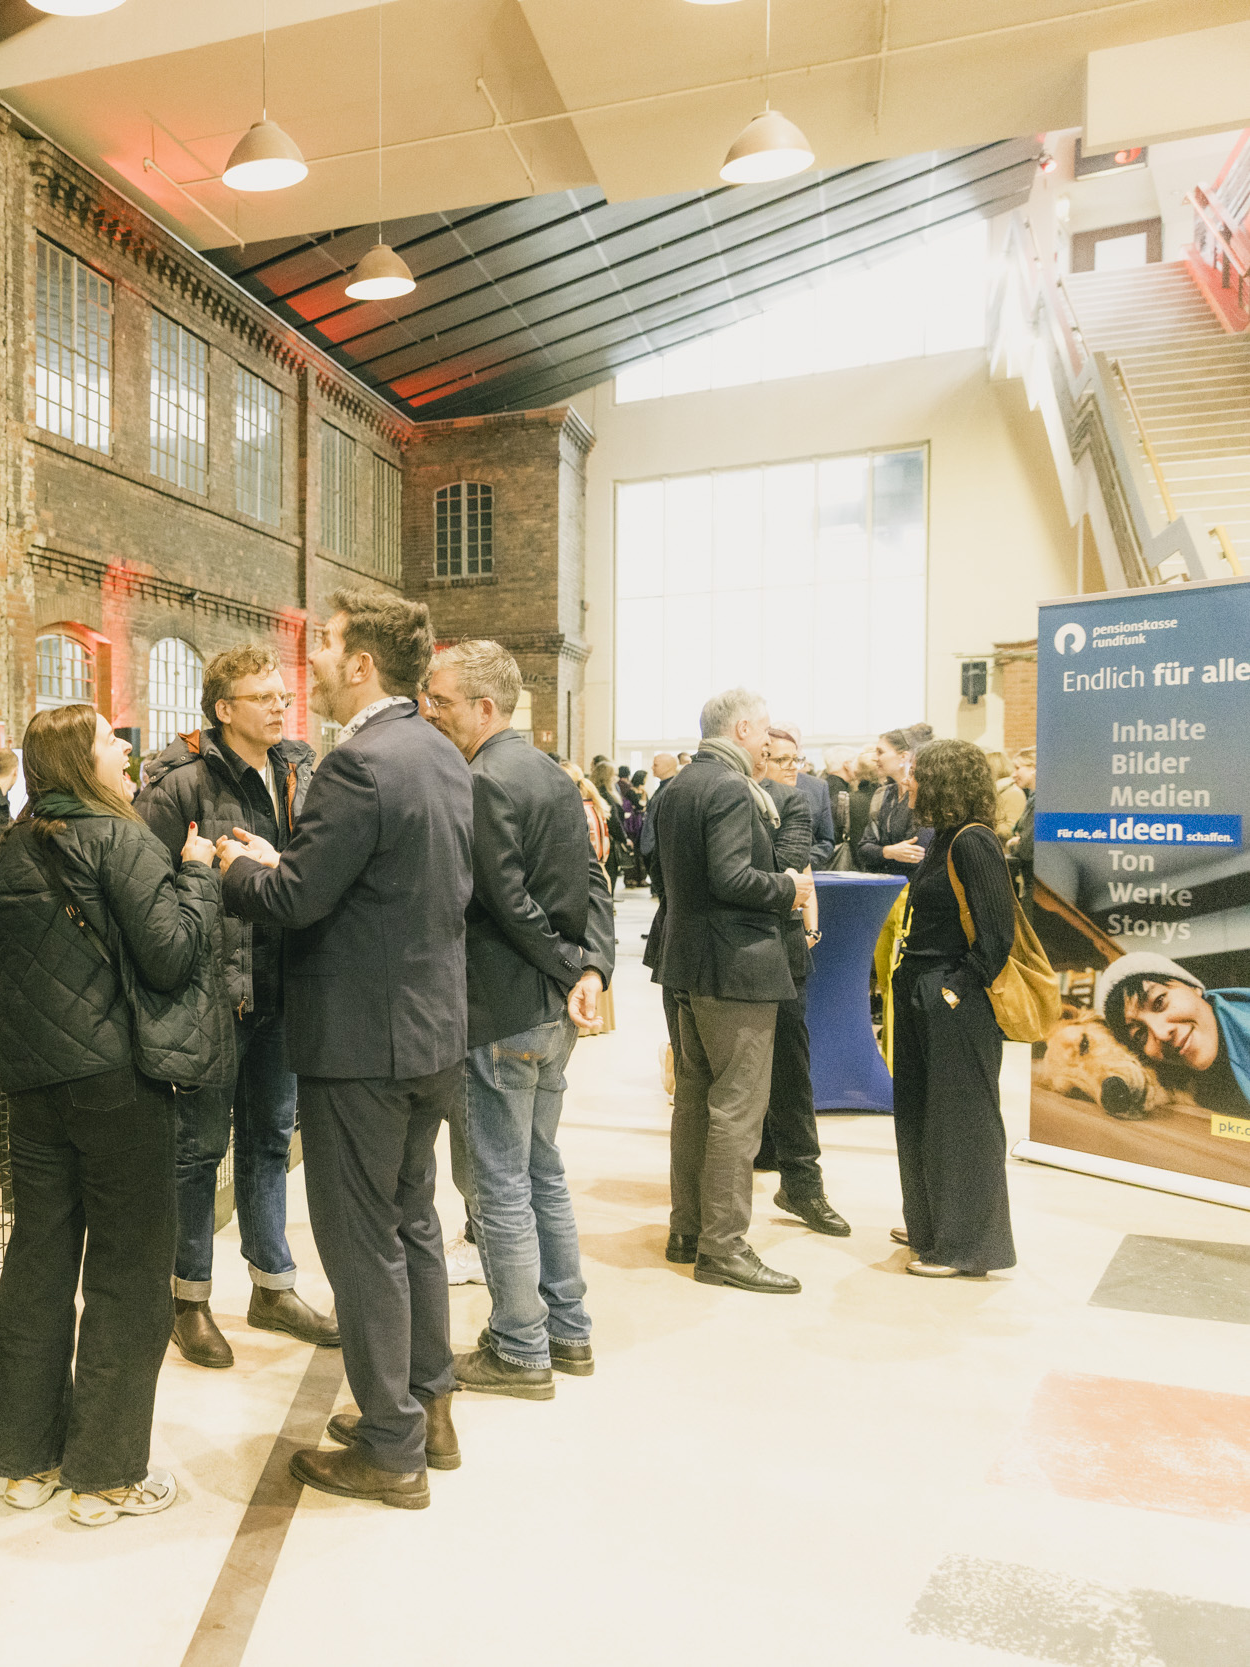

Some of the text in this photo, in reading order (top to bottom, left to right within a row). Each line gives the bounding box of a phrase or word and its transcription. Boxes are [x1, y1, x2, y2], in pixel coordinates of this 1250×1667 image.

[1092, 618, 1178, 638] pensionskasse
[1092, 633, 1147, 648] rundfunk
[1063, 657, 1250, 692] Endlich für alle
[1112, 718, 1206, 743] Inhalte
[1111, 752, 1190, 775] Bilder
[1110, 784, 1211, 808] Medien
[1057, 817, 1233, 842] Für die, die Ideen schaffen.
[1108, 850, 1154, 872] Ton
[1108, 882, 1193, 907] Werke
[1108, 914, 1191, 944] Storys
